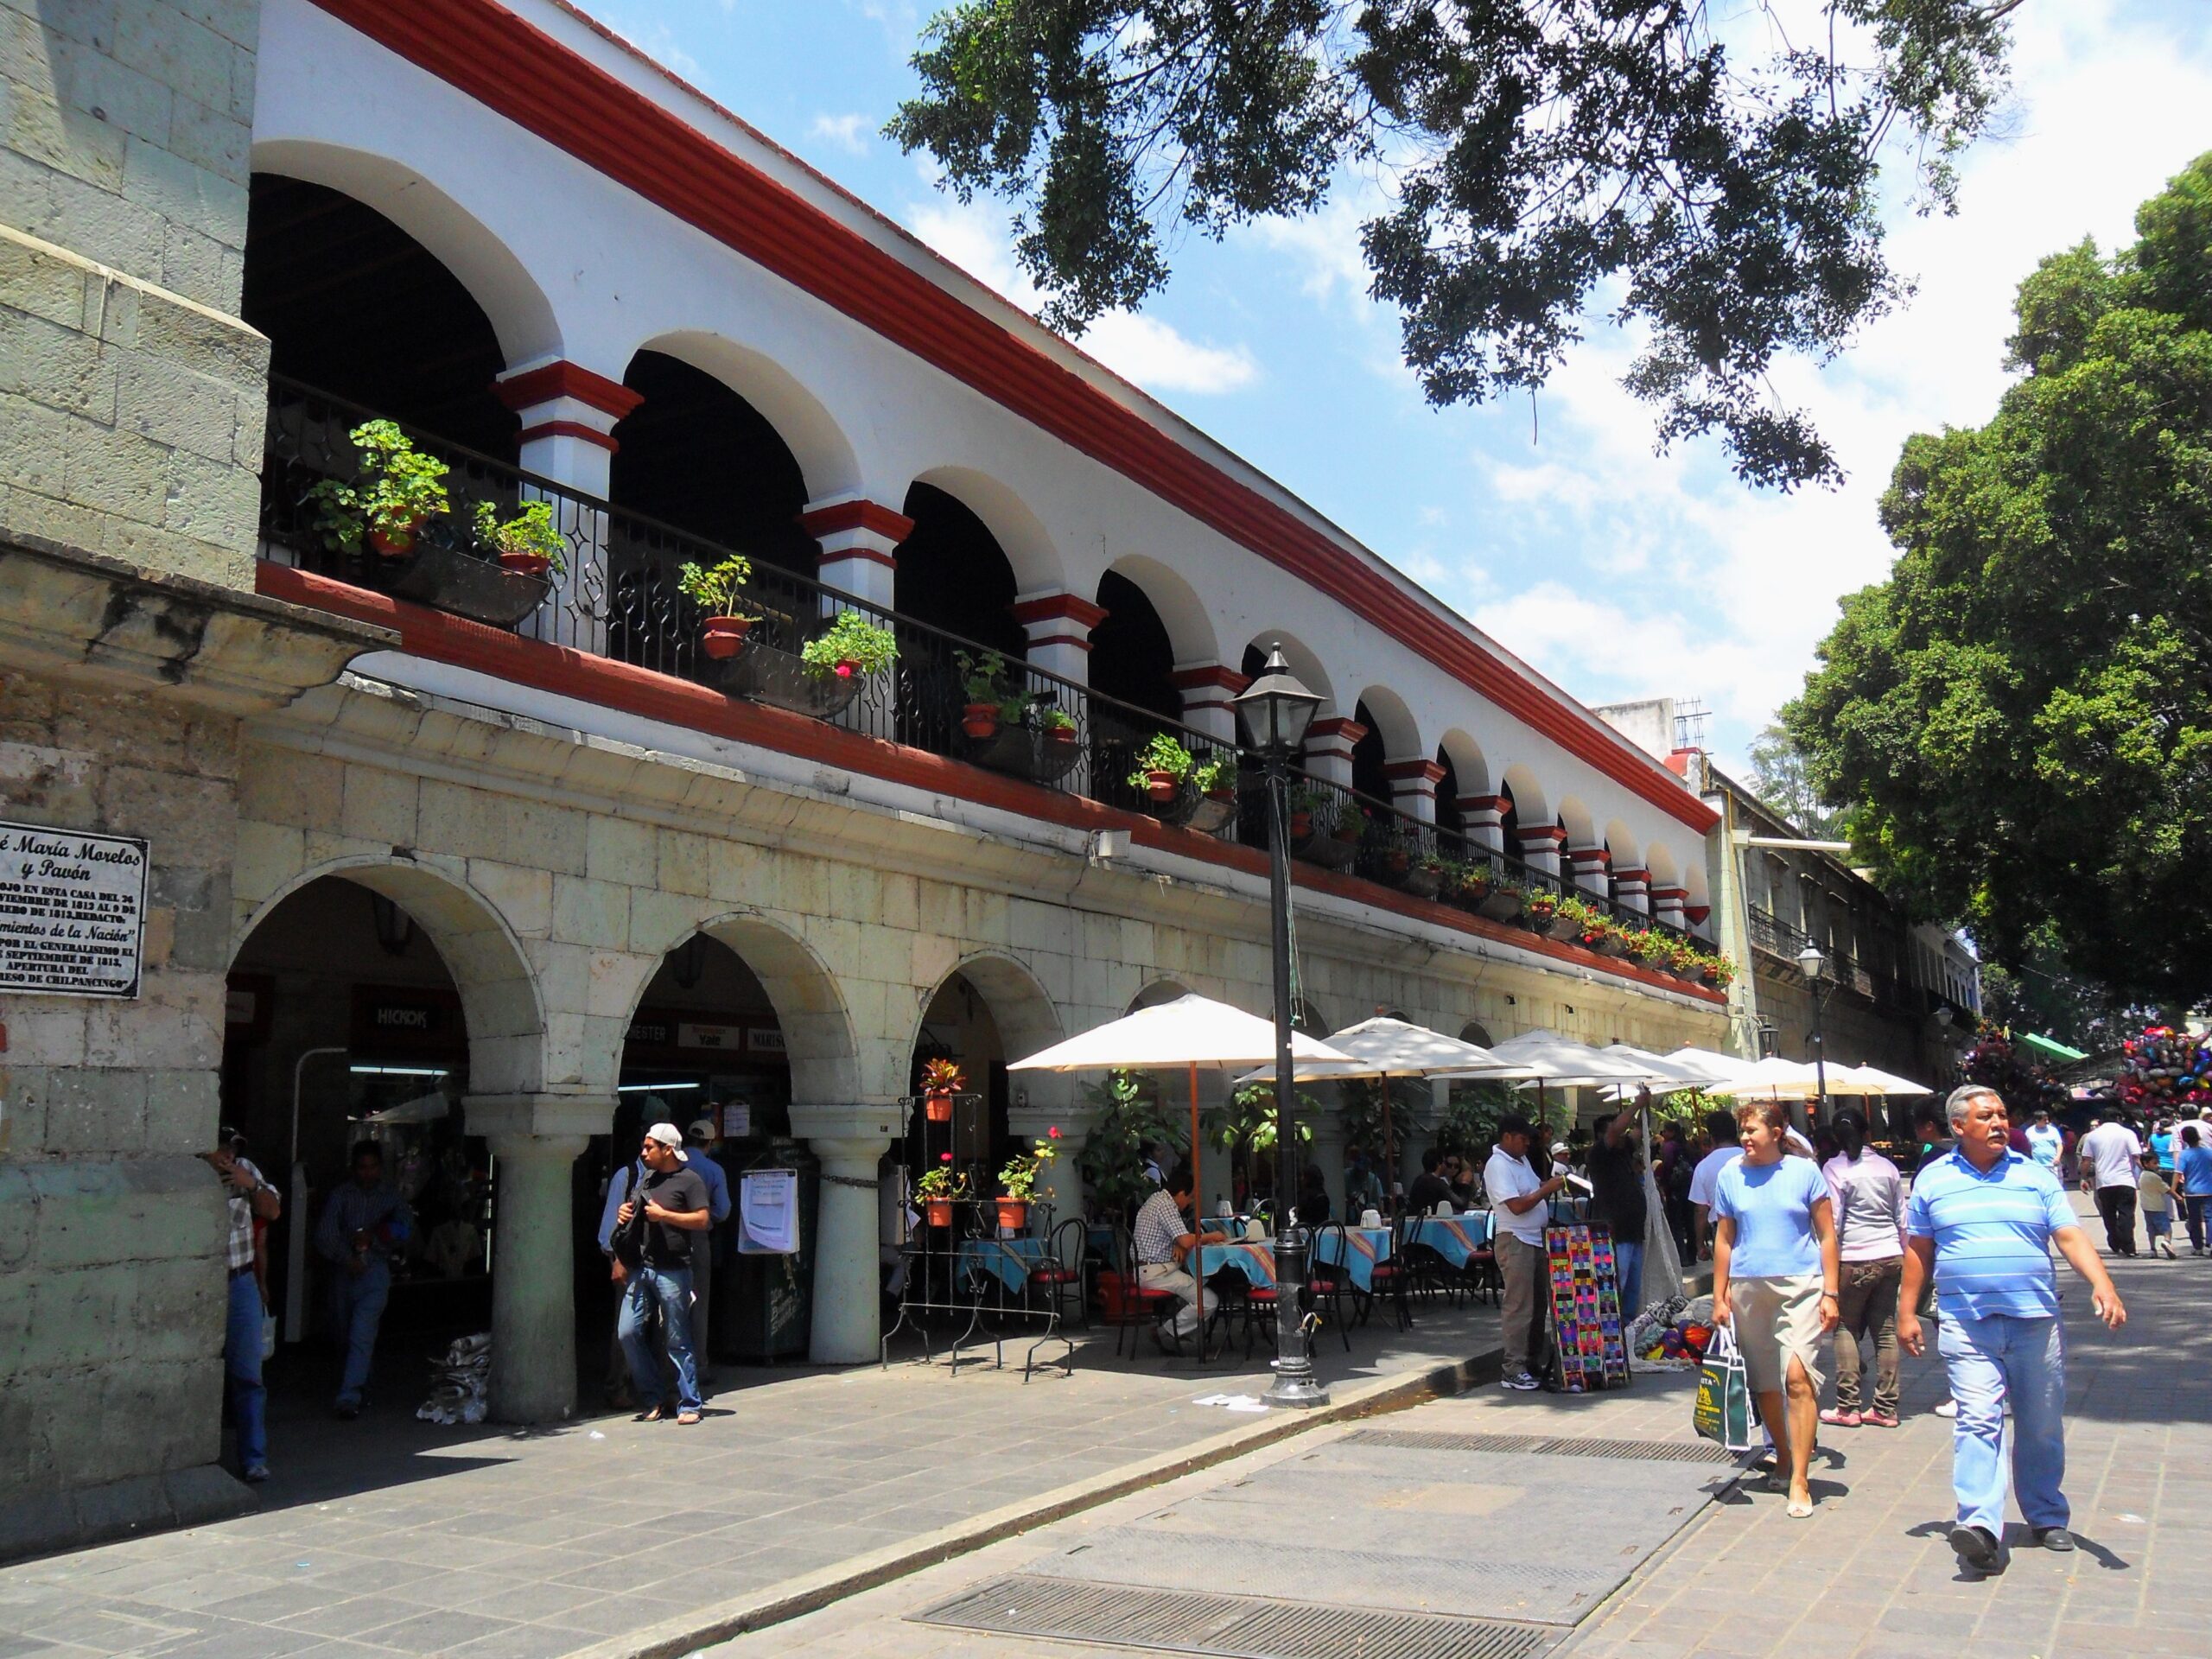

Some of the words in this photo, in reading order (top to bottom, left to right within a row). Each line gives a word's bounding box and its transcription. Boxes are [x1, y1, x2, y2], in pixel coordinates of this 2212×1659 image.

[13, 836, 70, 858] María
[74, 842, 140, 867] Morelos
[21, 862, 35, 880] y
[38, 859, 91, 881] Pavón
[24, 885, 39, 894] EN
[41, 886, 68, 897] ESTA
[70, 888, 97, 900] CASA
[99, 892, 119, 902] DEL
[30, 906, 46, 917] DE
[53, 898, 68, 908] DE
[72, 899, 94, 911] 1812
[97, 903, 111, 912] AL
[112, 904, 119, 913] 9
[121, 906, 136, 915] DE
[0, 920, 46, 936] mientos
[49, 922, 65, 938] de
[67, 924, 81, 938] la
[23, 940, 37, 950] EL
[40, 941, 120, 956] GENERALISIMO
[122, 947, 135, 957] EL
[5, 950, 76, 963] SEPTIEMBRE
[79, 955, 94, 965] DE
[6, 961, 65, 974] APERTURA
[67, 965, 89, 976] DEL
[28, 974, 43, 983] DE
[378, 1008, 428, 1027] HICKOK
